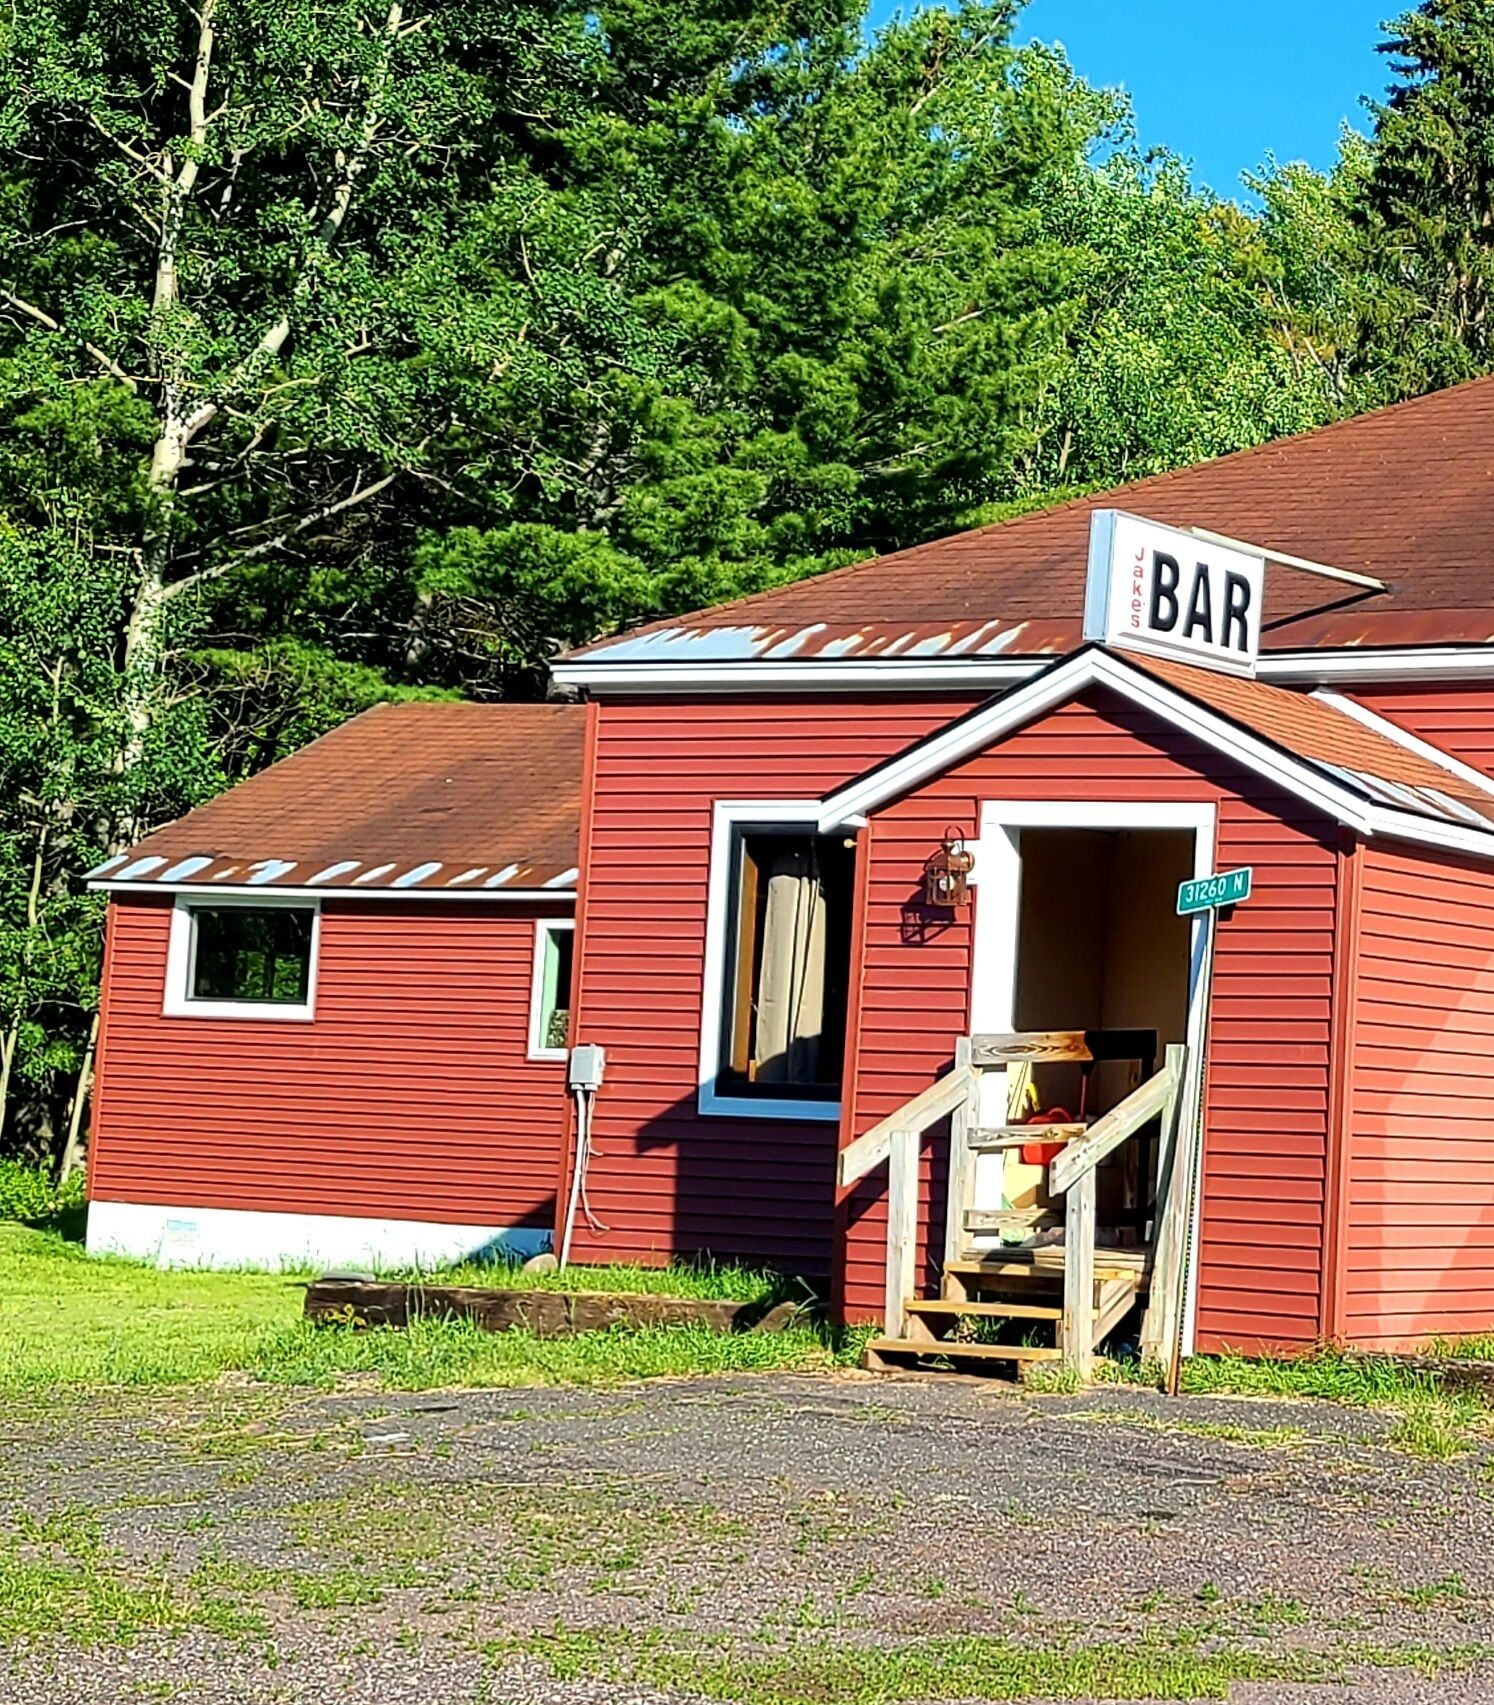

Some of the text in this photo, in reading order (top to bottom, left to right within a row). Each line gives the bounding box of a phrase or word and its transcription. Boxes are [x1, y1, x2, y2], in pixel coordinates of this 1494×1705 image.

[1148, 550, 1251, 653] BAR
[1185, 873, 1244, 903] 31260 N
